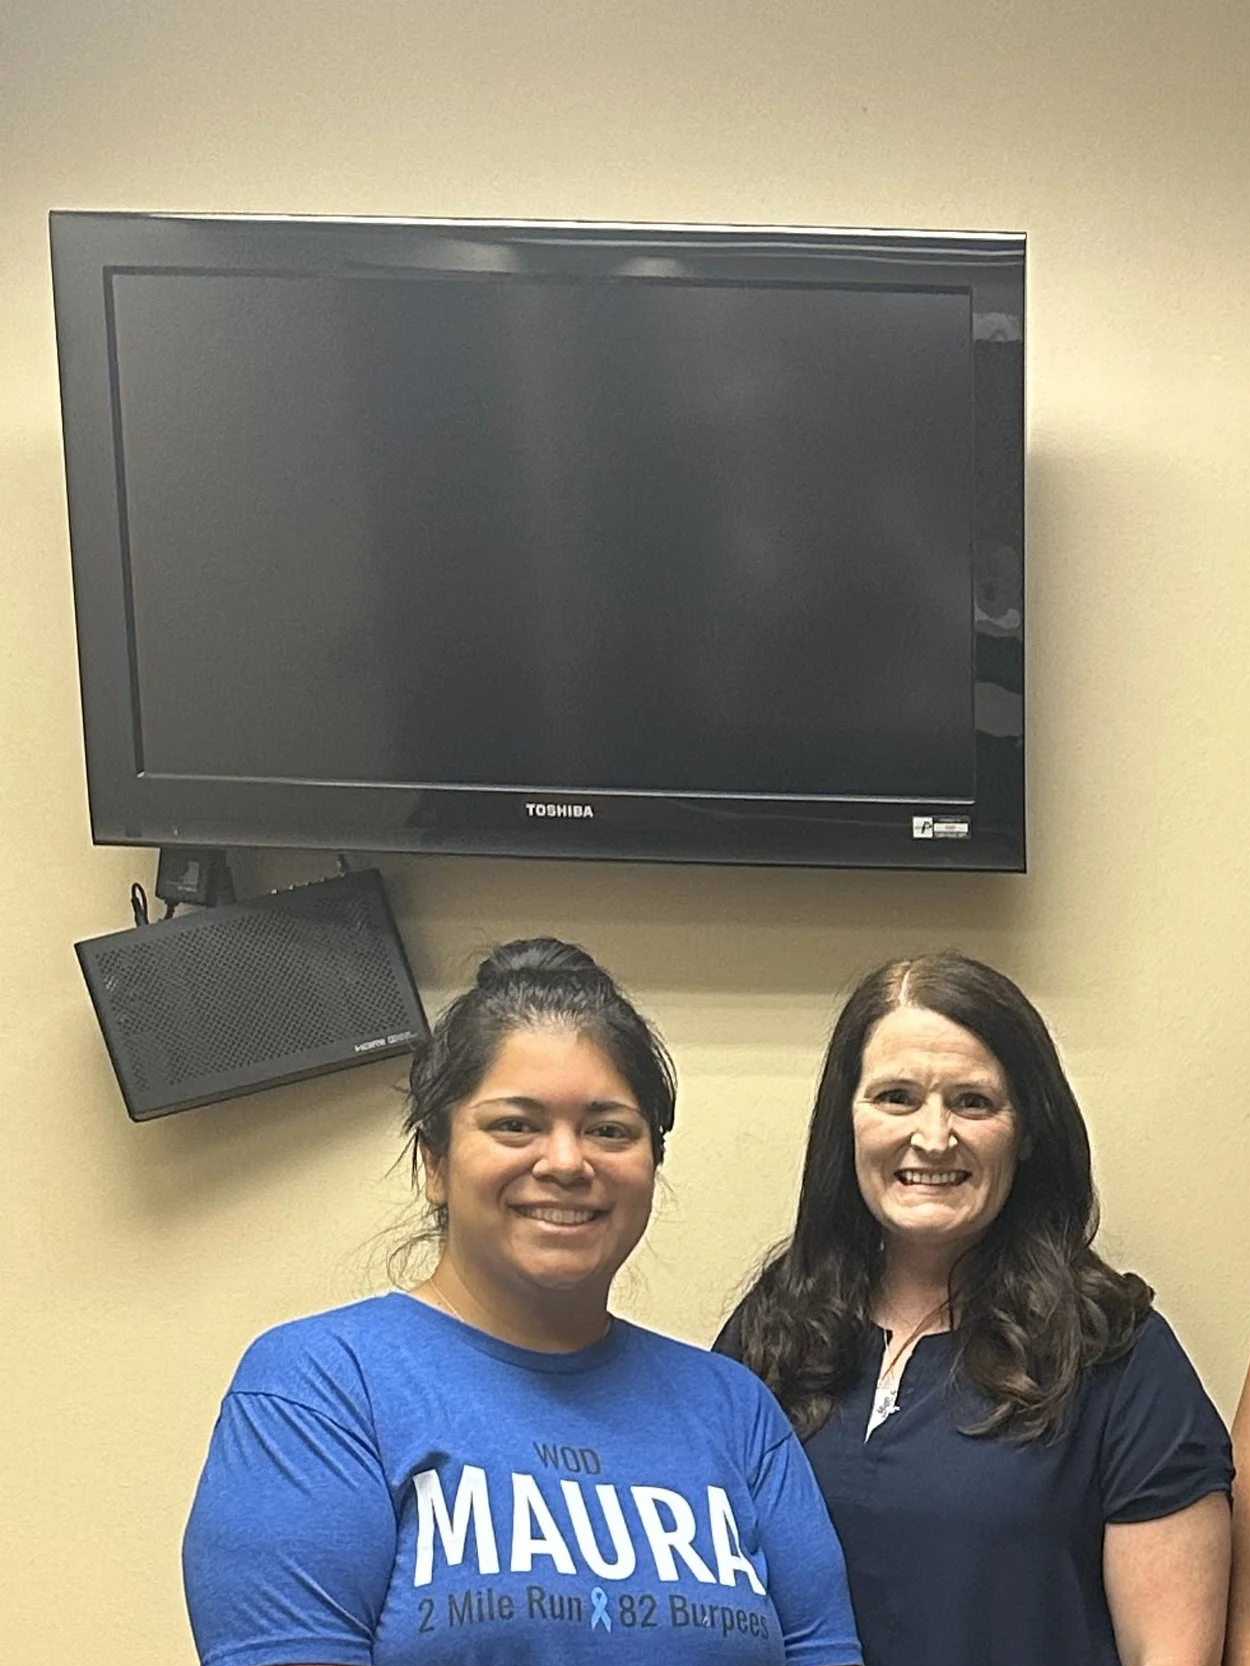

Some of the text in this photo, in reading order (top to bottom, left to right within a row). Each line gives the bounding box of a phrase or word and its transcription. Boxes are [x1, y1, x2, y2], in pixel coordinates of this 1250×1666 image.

[526, 803, 594, 818] TOSHIBA
[532, 1440, 601, 1476] WOD
[412, 1464, 767, 1596] MAURA
[418, 1585, 770, 1640] 2 Mile Run 82 Burpees
